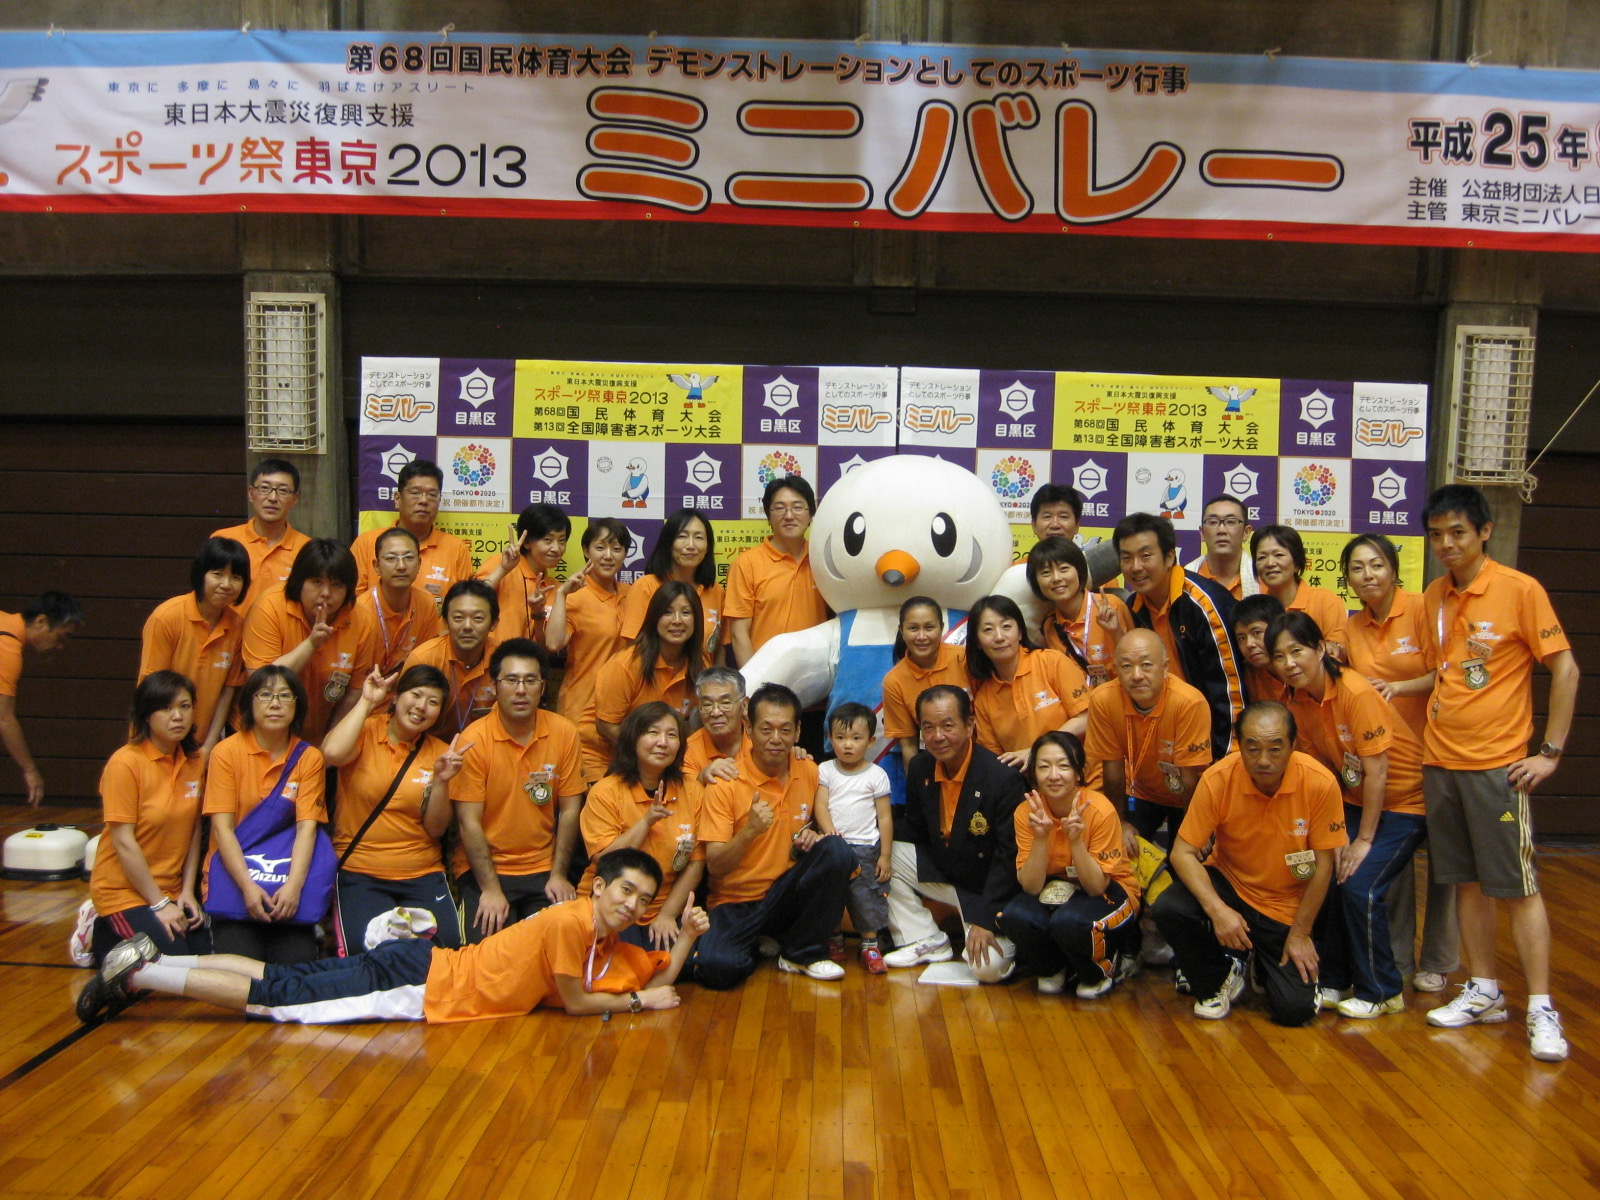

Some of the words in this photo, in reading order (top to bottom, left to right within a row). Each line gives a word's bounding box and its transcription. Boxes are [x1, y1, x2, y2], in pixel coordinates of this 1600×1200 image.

[346, 43, 633, 78] 第68回国民体育大会
[647, 46, 1190, 95] デモンストレーションとしてのスポーツ行事
[107, 81, 159, 94] 東京に
[177, 79, 228, 93] 多摩に
[248, 78, 299, 92] 島々に
[318, 80, 475, 94] 羽ばたけアスリート
[165, 99, 415, 129] 東日本大震災復興支援
[55, 130, 528, 188] スポーツ祭東京2013
[576, 85, 1344, 225] ミニバレー
[1408, 177, 1448, 198] 主催
[1461, 178, 1600, 205] 公益財団法人日
[1407, 202, 1447, 222] 主管
[369, 371, 432, 380] デモンストレーション
[566, 377, 638, 388] 東日本大震災復興支援
[369, 380, 432, 389] としてのスポーツ行事
[825, 381, 888, 390] デモンストレーション
[909, 382, 972, 392] デモンストレーション
[534, 385, 669, 405] スポーツ祭東京2013
[825, 390, 888, 399] としてのスポーツ行事
[908, 391, 971, 400] としてのスポーツ行事
[1106, 390, 1177, 400] 東日本大震災復興支援
[1359, 396, 1420, 406] デモンストレーション
[364, 394, 435, 422] ミニバレー
[1074, 398, 1207, 416] スポーツ祭東京2013
[1358, 405, 1420, 414] としてのスポーツ行事
[456, 412, 496, 425] 目黒区
[821, 403, 892, 433] ミニバレー
[904, 403, 975, 434] ミニバレー
[533, 421, 722, 438] 第13回全国障害者スポーツ大会
[760, 419, 802, 434] 目黒区
[995, 424, 1036, 438] 目黒区
[1354, 417, 1423, 448] ミニバレー
[1073, 433, 1259, 450] 第13回全国障害者スポーツ大会
[1296, 432, 1336, 447] 目黒区
[443, 499, 451, 508] 祝
[530, 491, 571, 506] 目黒区
[682, 496, 724, 510] 目黒区
[1284, 518, 1292, 527] 祝
[1369, 510, 1408, 525] 目黒区
